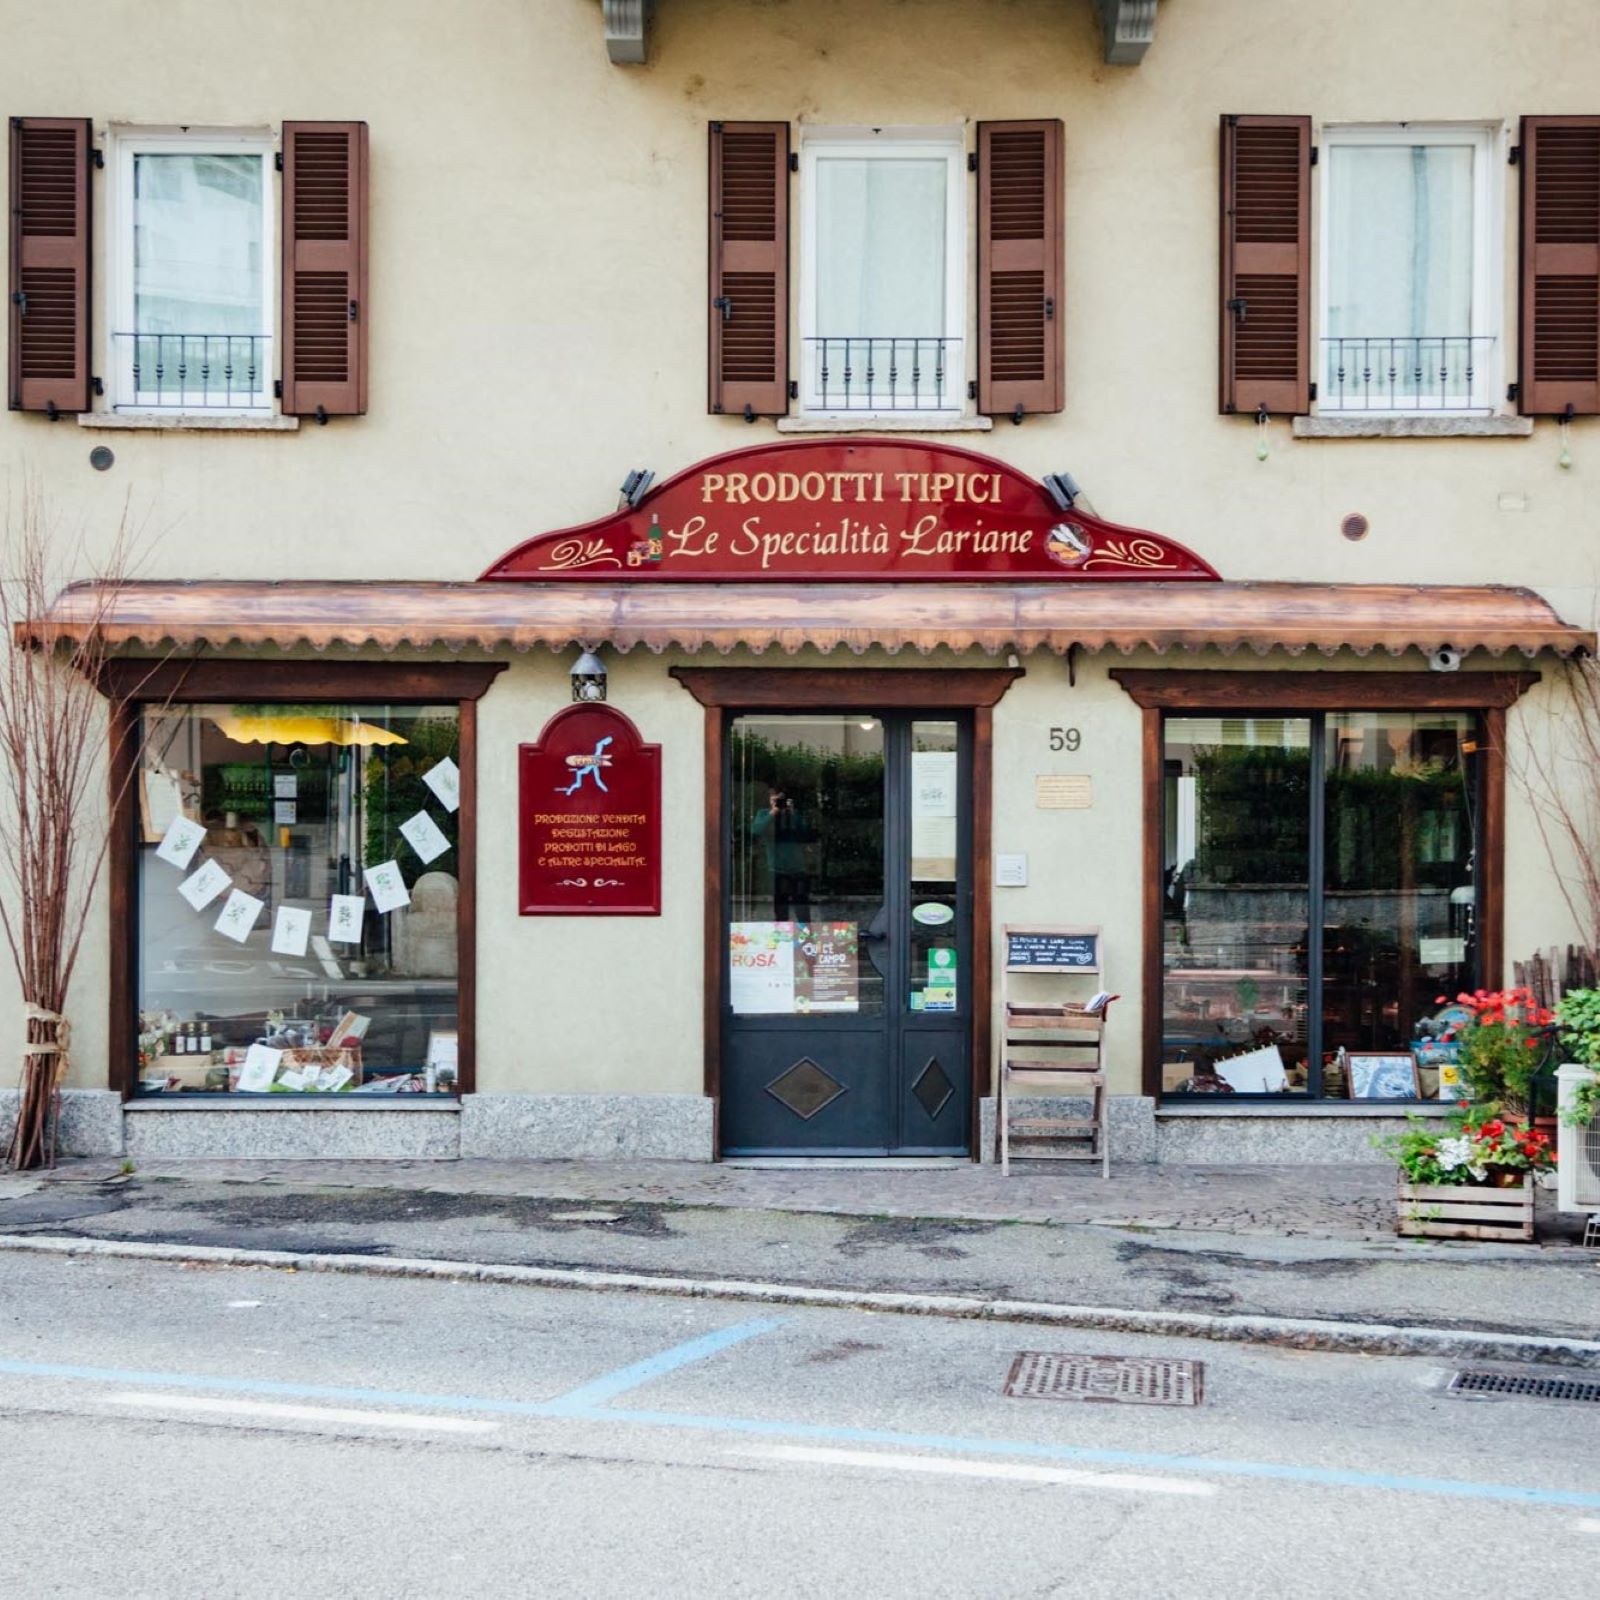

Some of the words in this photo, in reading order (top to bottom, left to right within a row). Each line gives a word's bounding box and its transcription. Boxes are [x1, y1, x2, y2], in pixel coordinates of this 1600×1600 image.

[701, 472, 884, 504] PRODOTTI
[896, 472, 1003, 503] TIPICI
[667, 515, 719, 557] Le
[730, 517, 890, 570] Specialità
[900, 515, 1034, 557] Lariane
[1049, 727, 1081, 751] 59
[602, 814, 647, 824] VENDITA
[544, 842, 594, 852] PRODOTTI
[608, 842, 637, 852] LAGO
